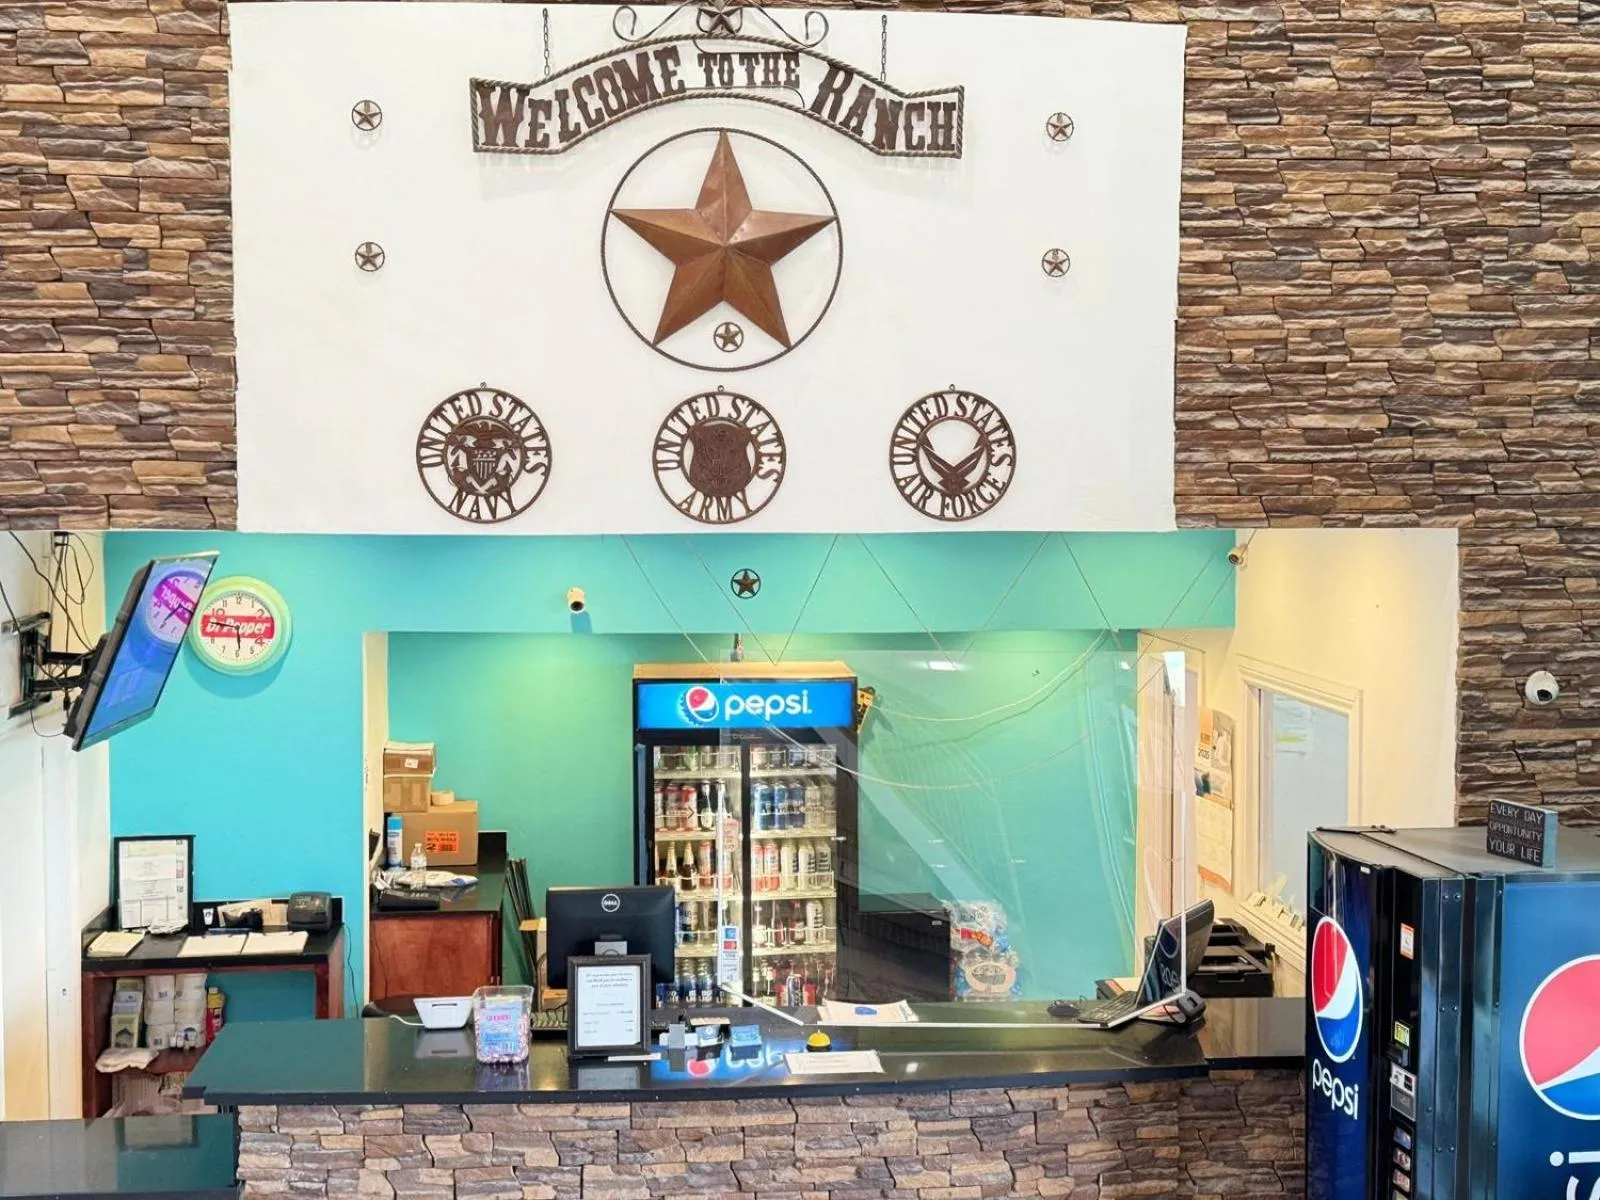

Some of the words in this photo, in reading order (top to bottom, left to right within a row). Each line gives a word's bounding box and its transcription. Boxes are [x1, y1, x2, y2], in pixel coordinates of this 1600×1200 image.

[477, 45, 687, 148] WELCOME
[697, 53, 733, 88] TO
[739, 51, 800, 88] THE
[809, 63, 956, 151] RANCH
[419, 391, 483, 468] UNITED
[489, 391, 549, 474] STATES
[656, 395, 721, 470] UNITED
[731, 395, 783, 481] STATES
[893, 394, 948, 466] UNITED
[954, 394, 1012, 468] STATES
[446, 490, 517, 520] NAVY
[679, 490, 752, 522] ARMY
[898, 474, 929, 511] AIR
[940, 473, 1006, 519] FORCE
[221, 617, 269, 635] Pepper
[724, 690, 810, 720] pepsi
[1490, 803, 1520, 818] EVERY
[1524, 810, 1543, 824] DAY
[1489, 821, 1542, 841] OPPORTUNITY
[1489, 838, 1515, 856] YOUR
[1521, 845, 1541, 862] LIFE
[1313, 1058, 1359, 1120] pepsi
